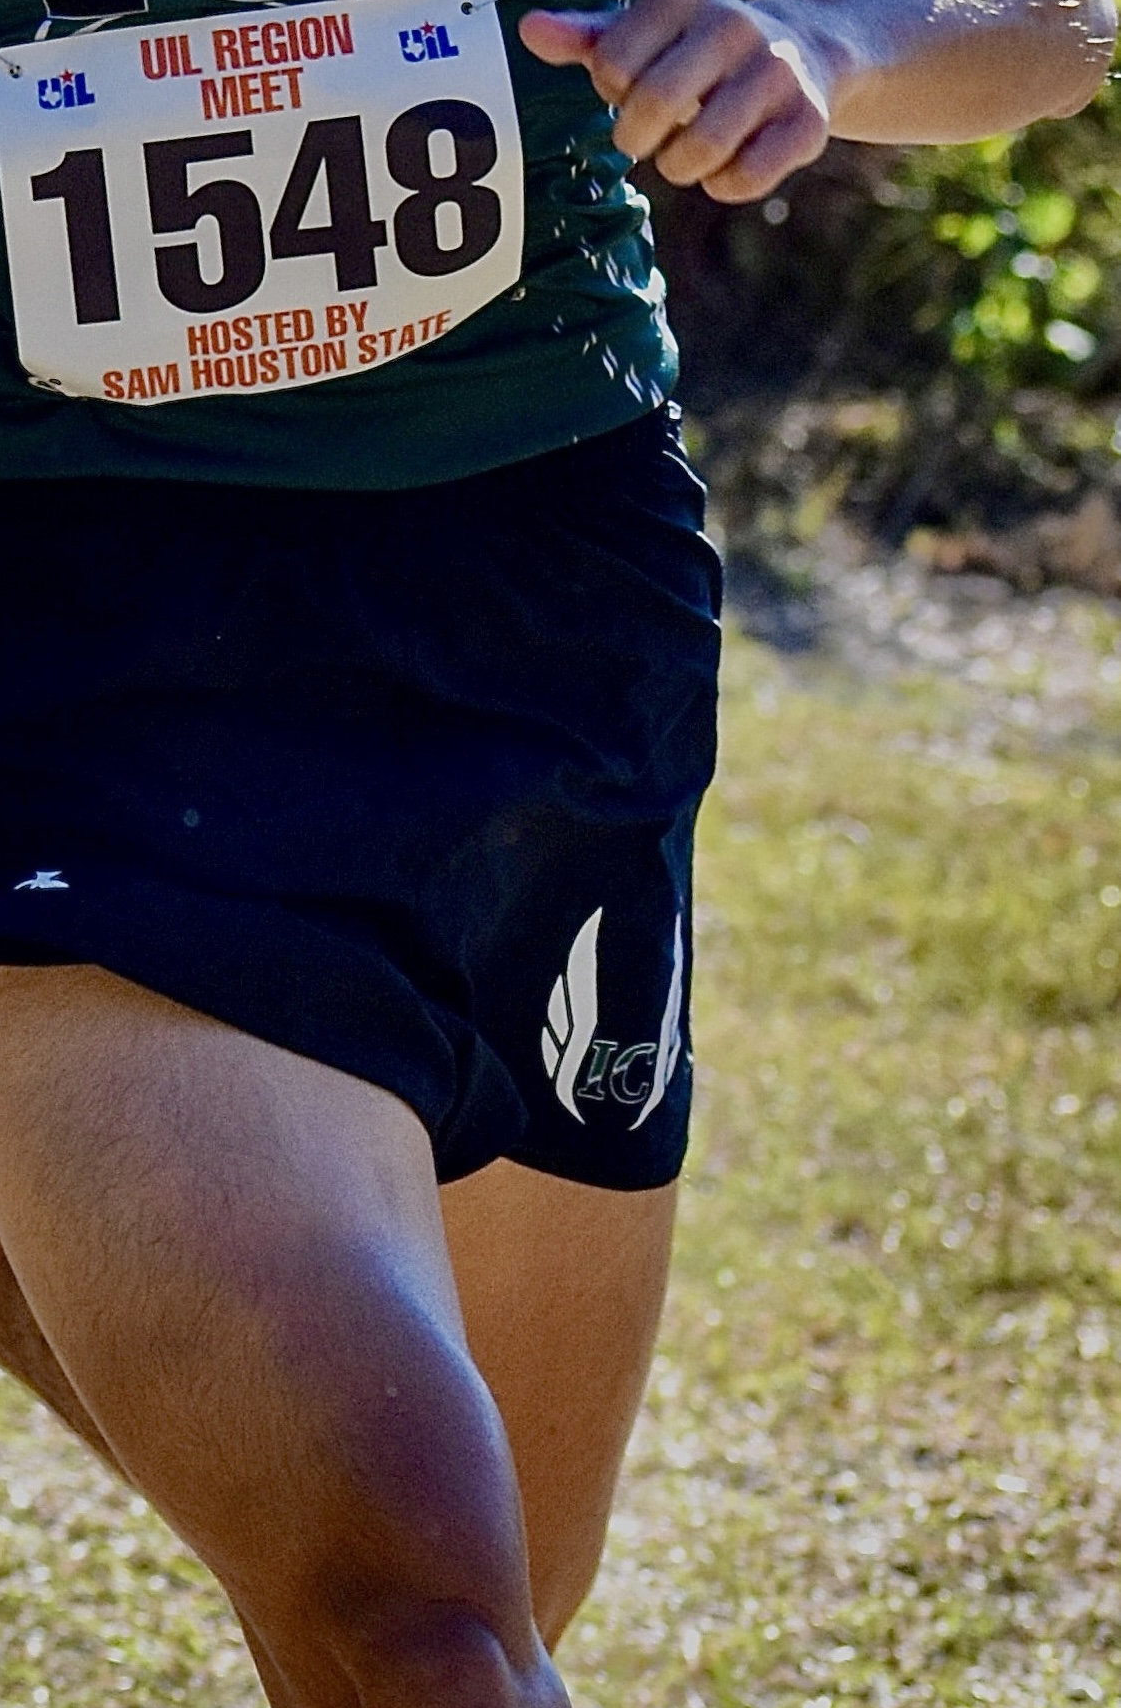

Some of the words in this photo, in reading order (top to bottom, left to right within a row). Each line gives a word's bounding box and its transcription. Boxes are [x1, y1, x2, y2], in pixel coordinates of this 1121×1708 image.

[141, 36, 202, 80] UIL
[212, 14, 353, 71] REGION
[398, 23, 460, 63] UIL
[38, 71, 95, 110] UIL
[201, 67, 303, 120] MEET
[30, 99, 502, 325] 1548
[103, 363, 180, 399] SAM
[191, 341, 347, 390] HOUSTON
[359, 309, 452, 365] STATE
[187, 309, 314, 356] HOSTED
[325, 301, 368, 337] BY
[577, 1039, 657, 1104] IC
